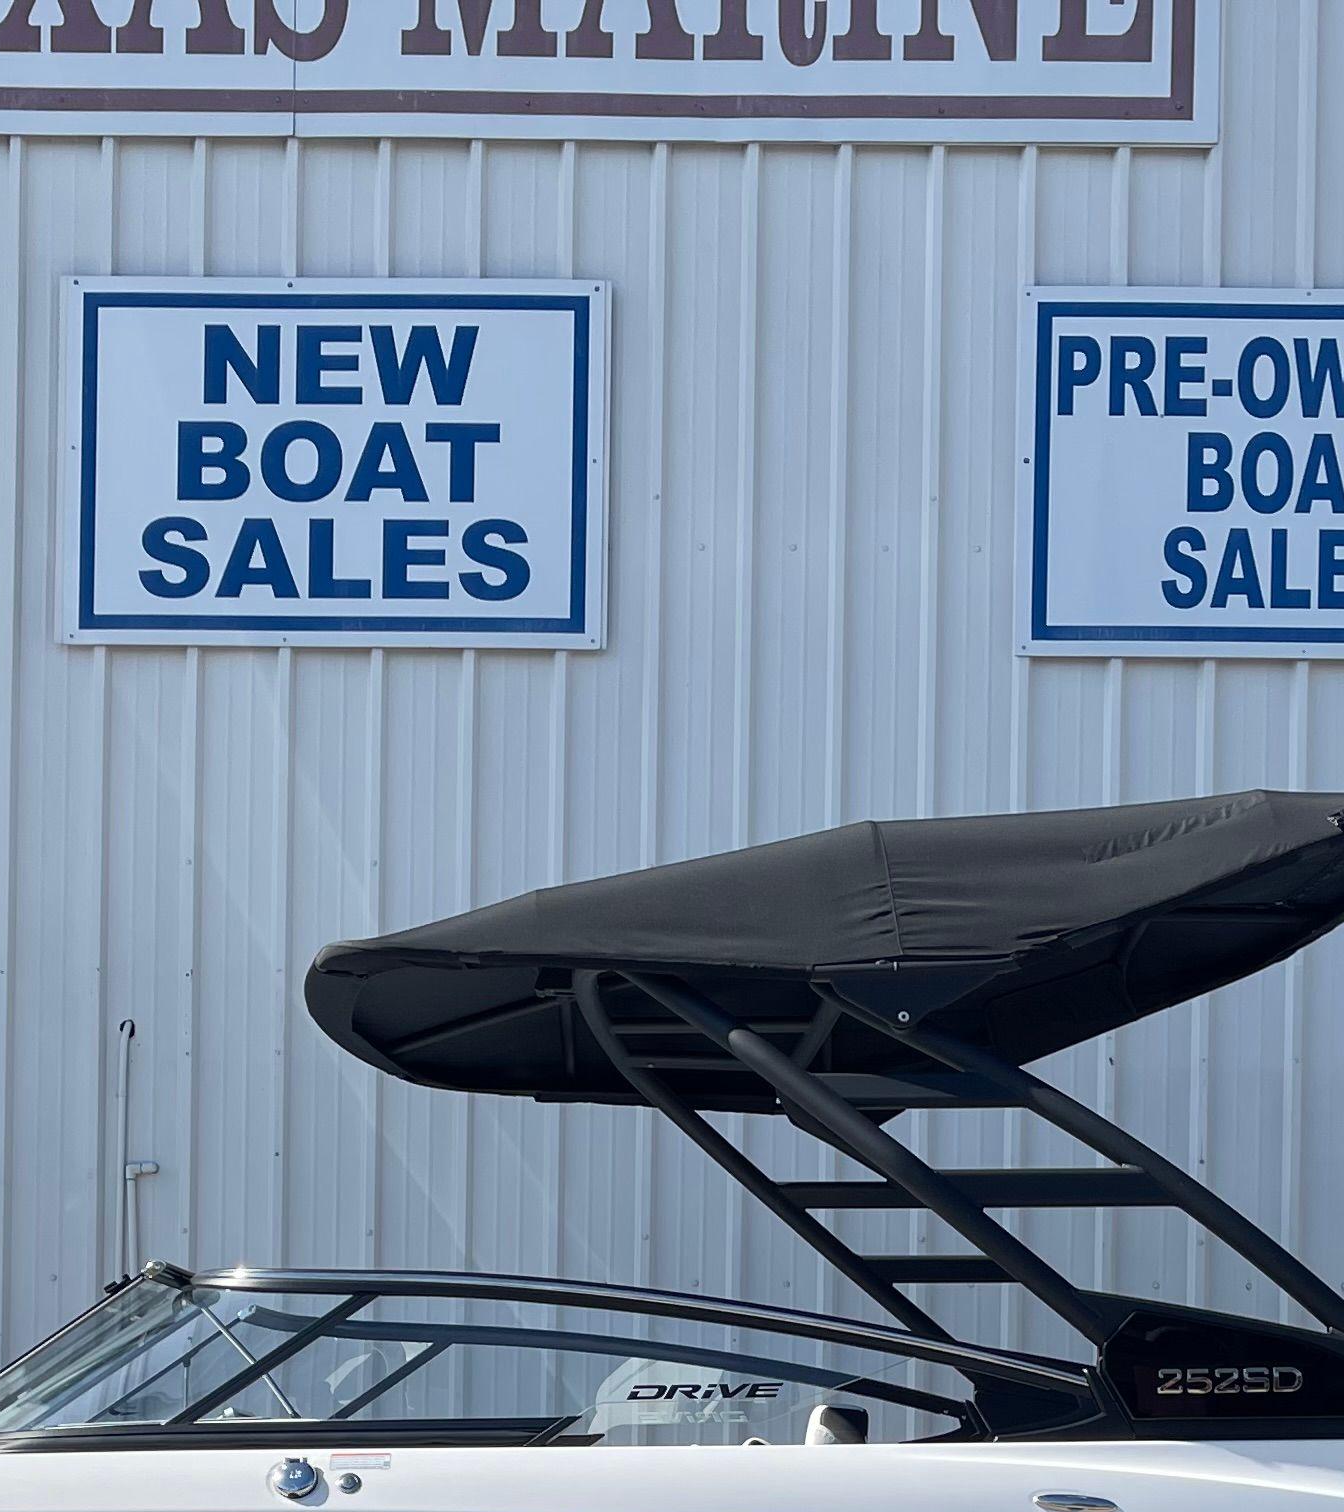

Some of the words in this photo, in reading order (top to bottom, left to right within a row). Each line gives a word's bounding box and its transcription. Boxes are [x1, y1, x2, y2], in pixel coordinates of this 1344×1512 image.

[203, 324, 479, 406] NEW
[177, 420, 501, 503] BOAT
[138, 516, 531, 602] SALES
[1156, 1366, 1303, 1394] 252SD
